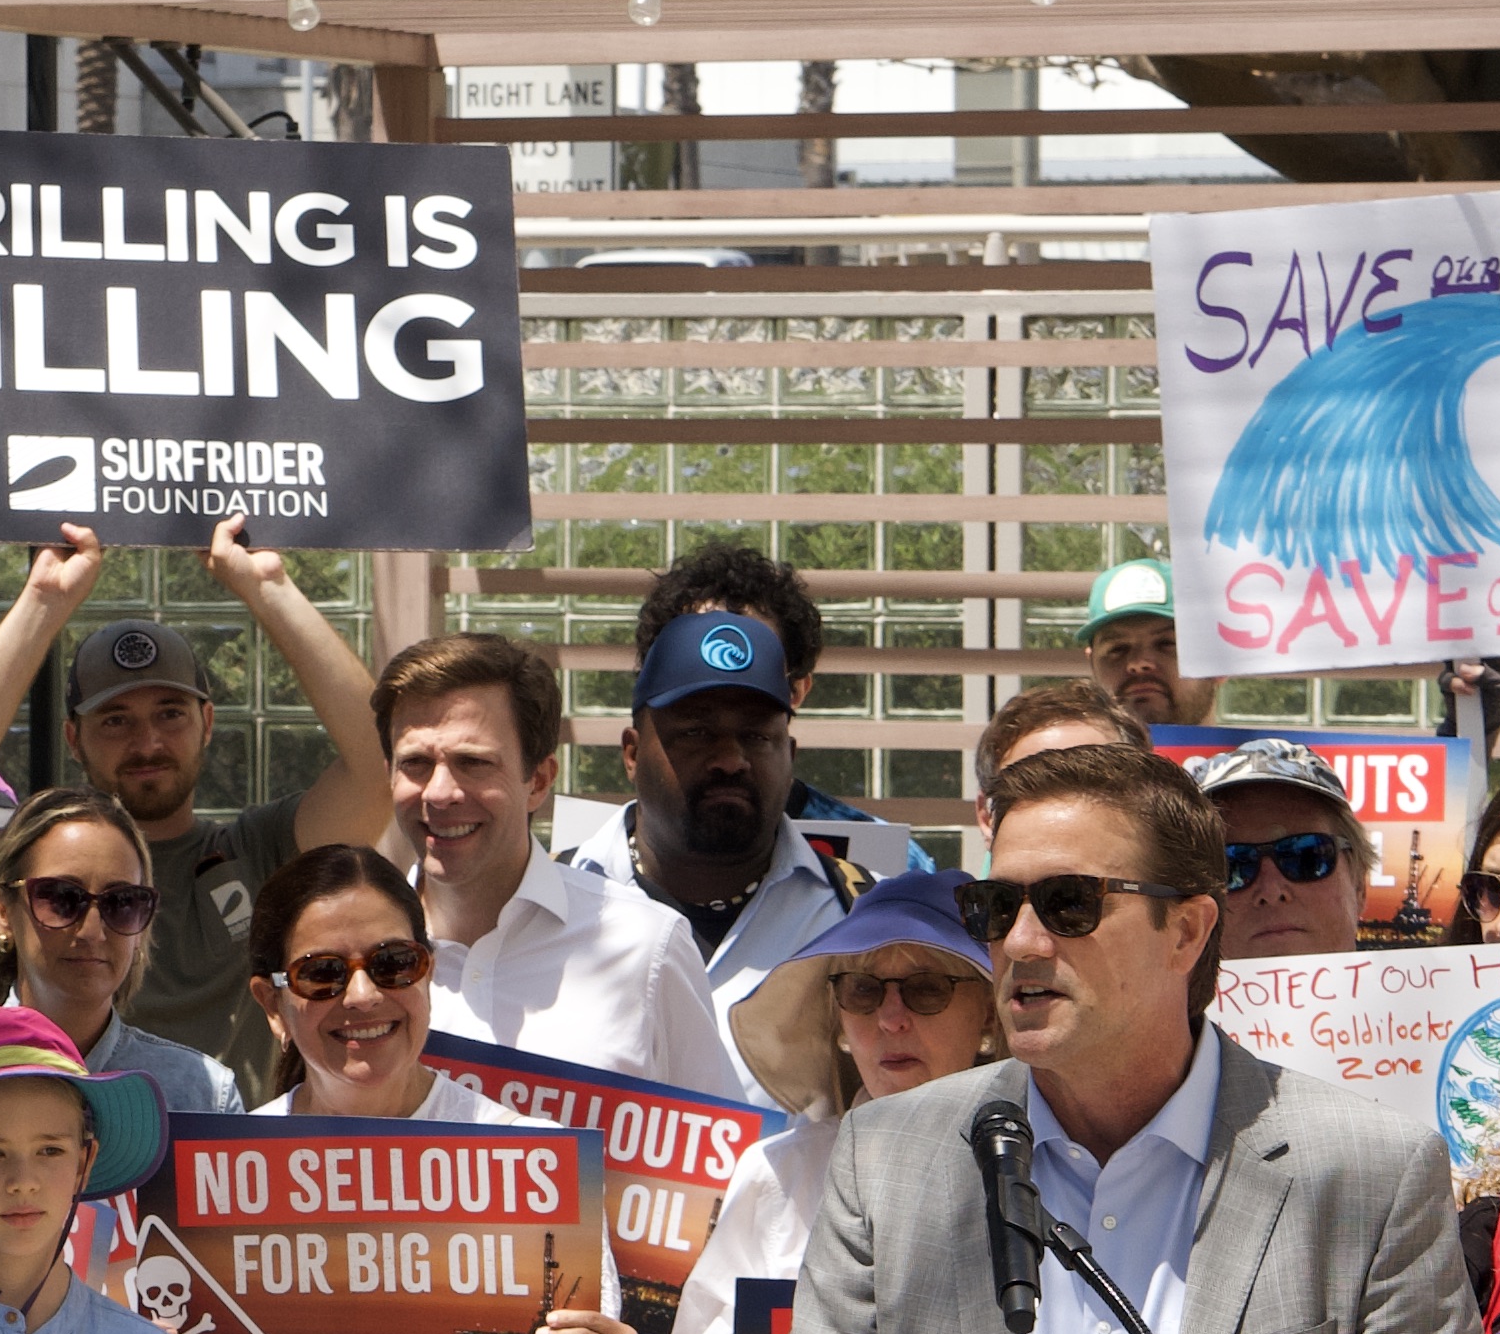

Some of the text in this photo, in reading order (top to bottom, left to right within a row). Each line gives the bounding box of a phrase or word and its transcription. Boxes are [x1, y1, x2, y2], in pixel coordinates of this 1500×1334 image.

[466, 81, 604, 107] RIGHT LANE
[387, 193, 478, 270] IS
[1184, 248, 1414, 374] SAVE
[102, 438, 326, 485] SURFRIDER
[102, 487, 328, 518] FOUNDATION
[1217, 552, 1478, 654] SAVE
[1248, 1019, 1294, 1050] the
[1311, 1011, 1454, 1052] Goldilocks
[195, 1146, 560, 1215] NO SELLOUTS
[617, 1184, 691, 1252] OIL
[232, 1232, 529, 1298] FOR BIG OIL
